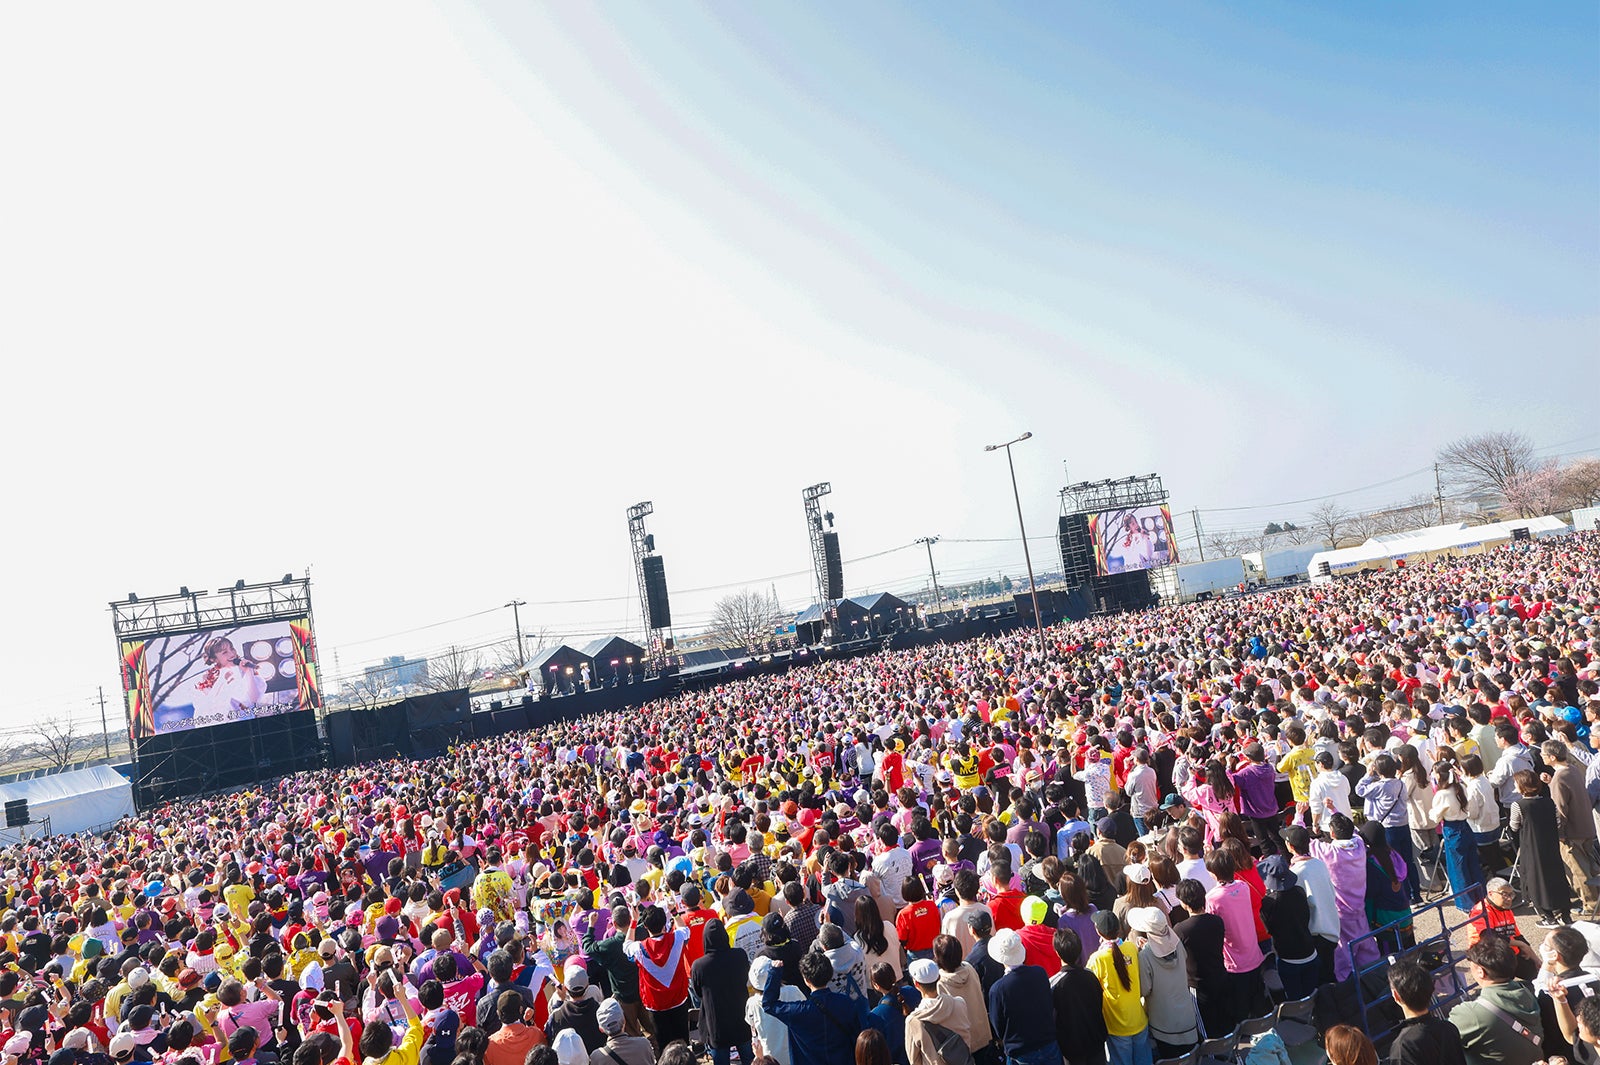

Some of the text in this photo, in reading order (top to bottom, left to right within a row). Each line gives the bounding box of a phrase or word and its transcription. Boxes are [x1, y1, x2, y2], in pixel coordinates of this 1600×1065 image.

[162, 713, 225, 730] パンダみたいな
[959, 764, 978, 775] MCZ
